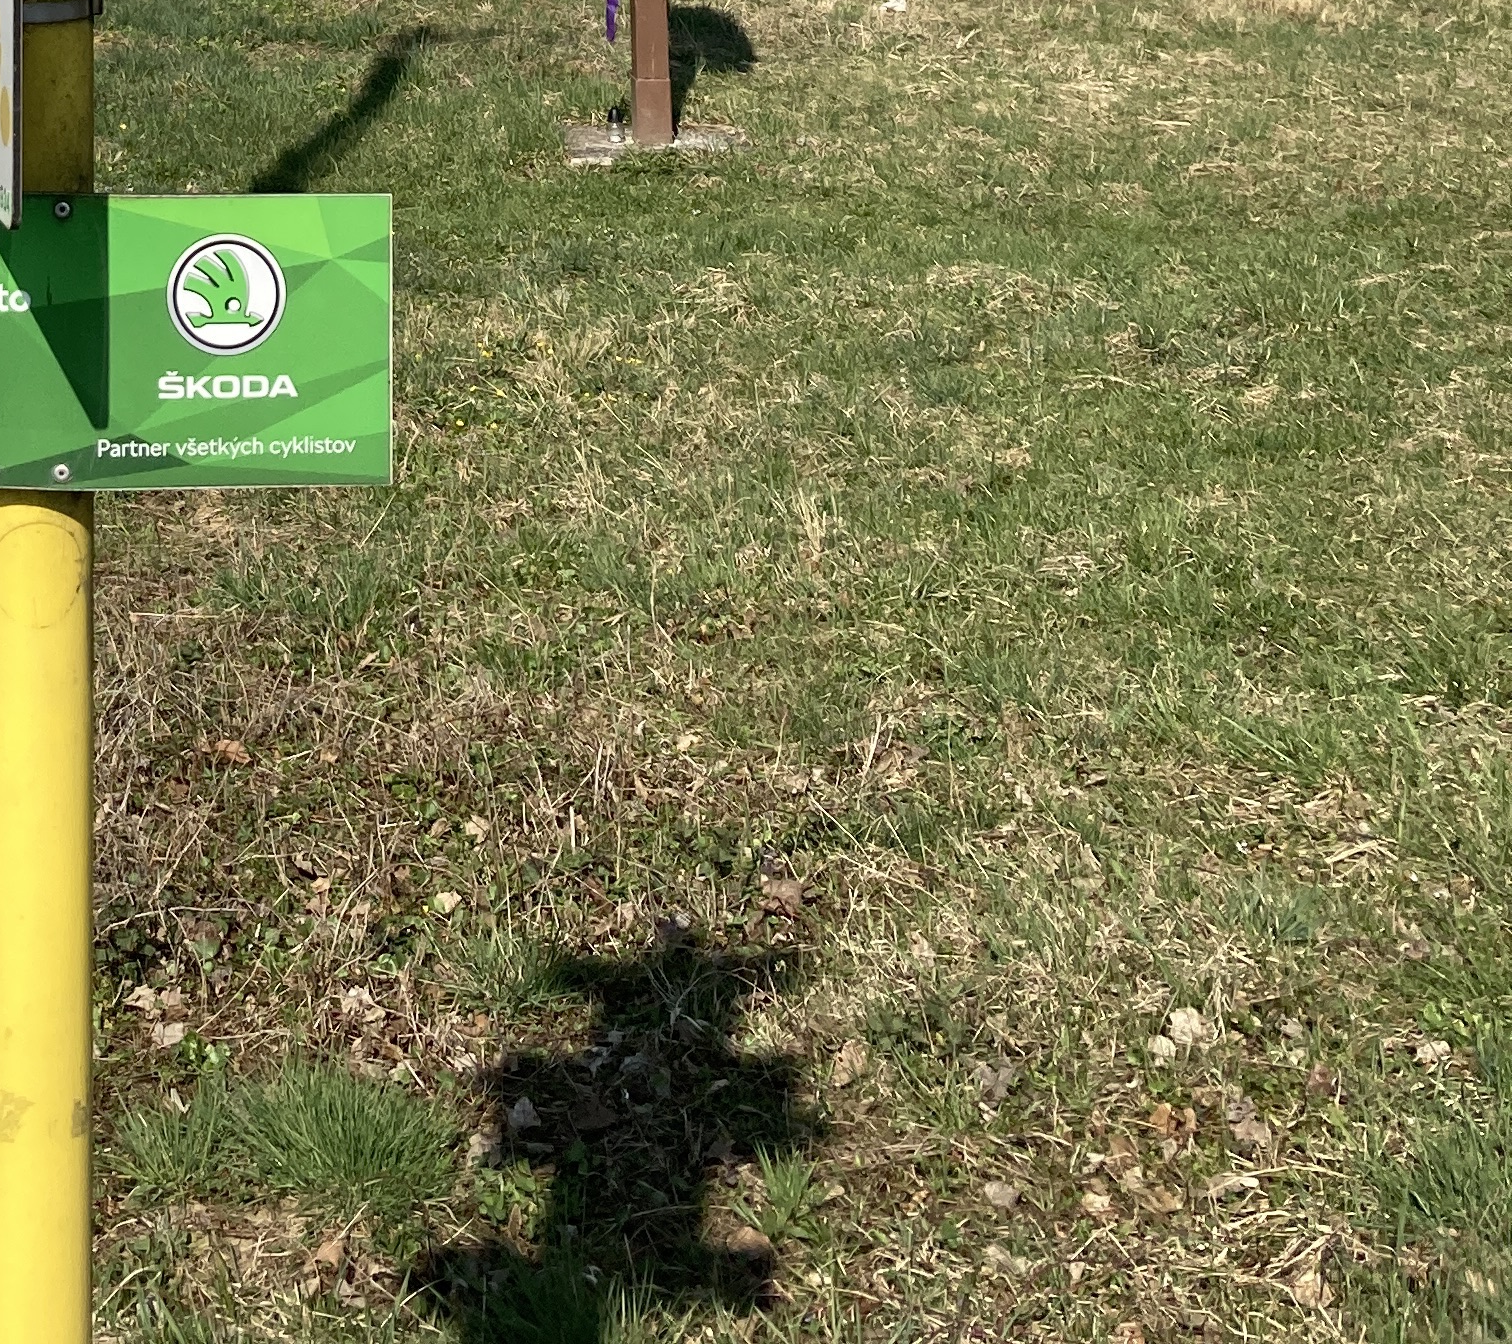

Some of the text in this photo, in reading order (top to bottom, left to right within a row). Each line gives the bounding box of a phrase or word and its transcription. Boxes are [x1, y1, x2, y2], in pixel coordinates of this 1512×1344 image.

[159, 371, 298, 399] ŠKODA
[98, 436, 356, 459] Partner všetkých cyklistov
